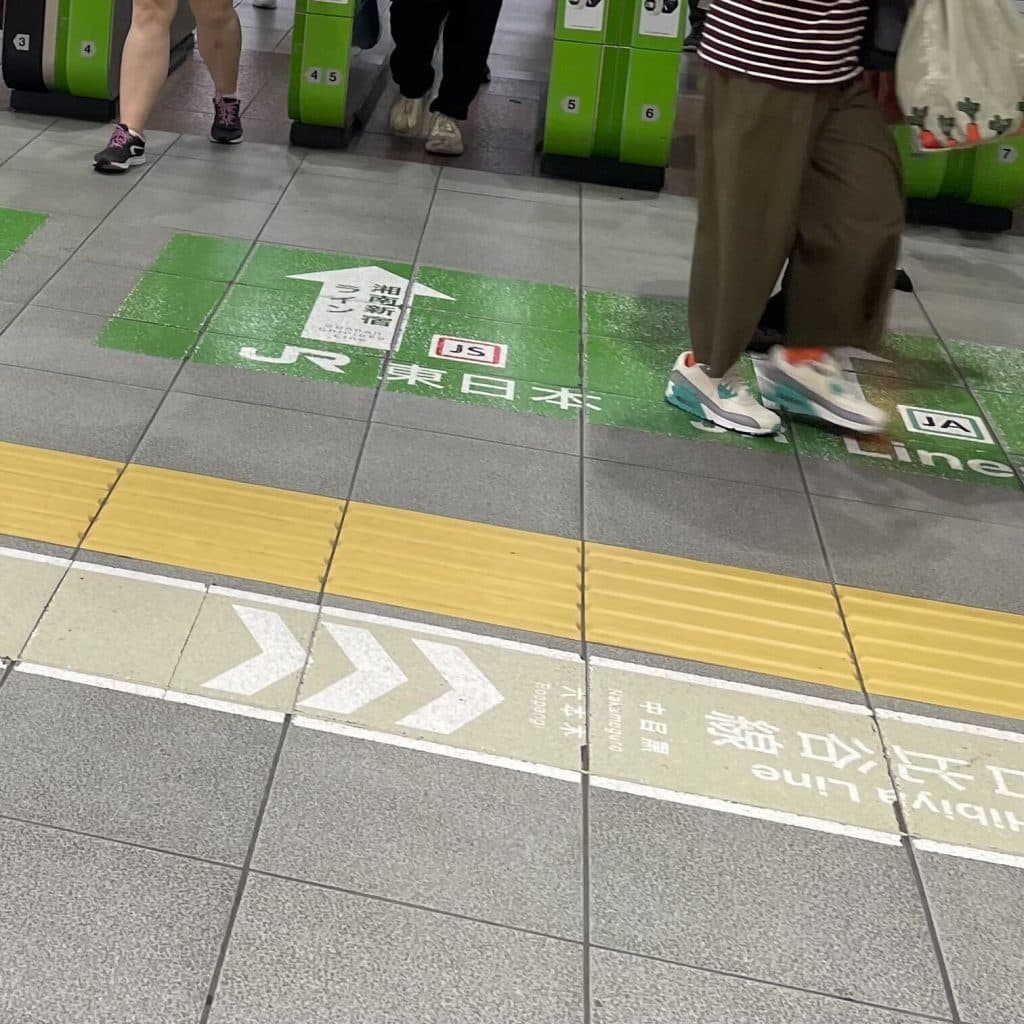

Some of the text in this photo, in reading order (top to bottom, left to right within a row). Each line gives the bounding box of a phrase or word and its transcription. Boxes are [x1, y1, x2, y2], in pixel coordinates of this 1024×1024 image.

[19, 37, 26, 47] 3
[83, 44, 91, 55] 4
[310, 70, 337, 83] 4 5
[567, 99, 577, 110] 5
[645, 108, 655, 119] 6
[1003, 148, 1012, 160] 7
[326, 283, 361, 314] ライン
[361, 283, 402, 327] 湘南新宿
[449, 342, 488, 359] JS
[922, 415, 972, 434] JA
[751, 763, 861, 803] Line
